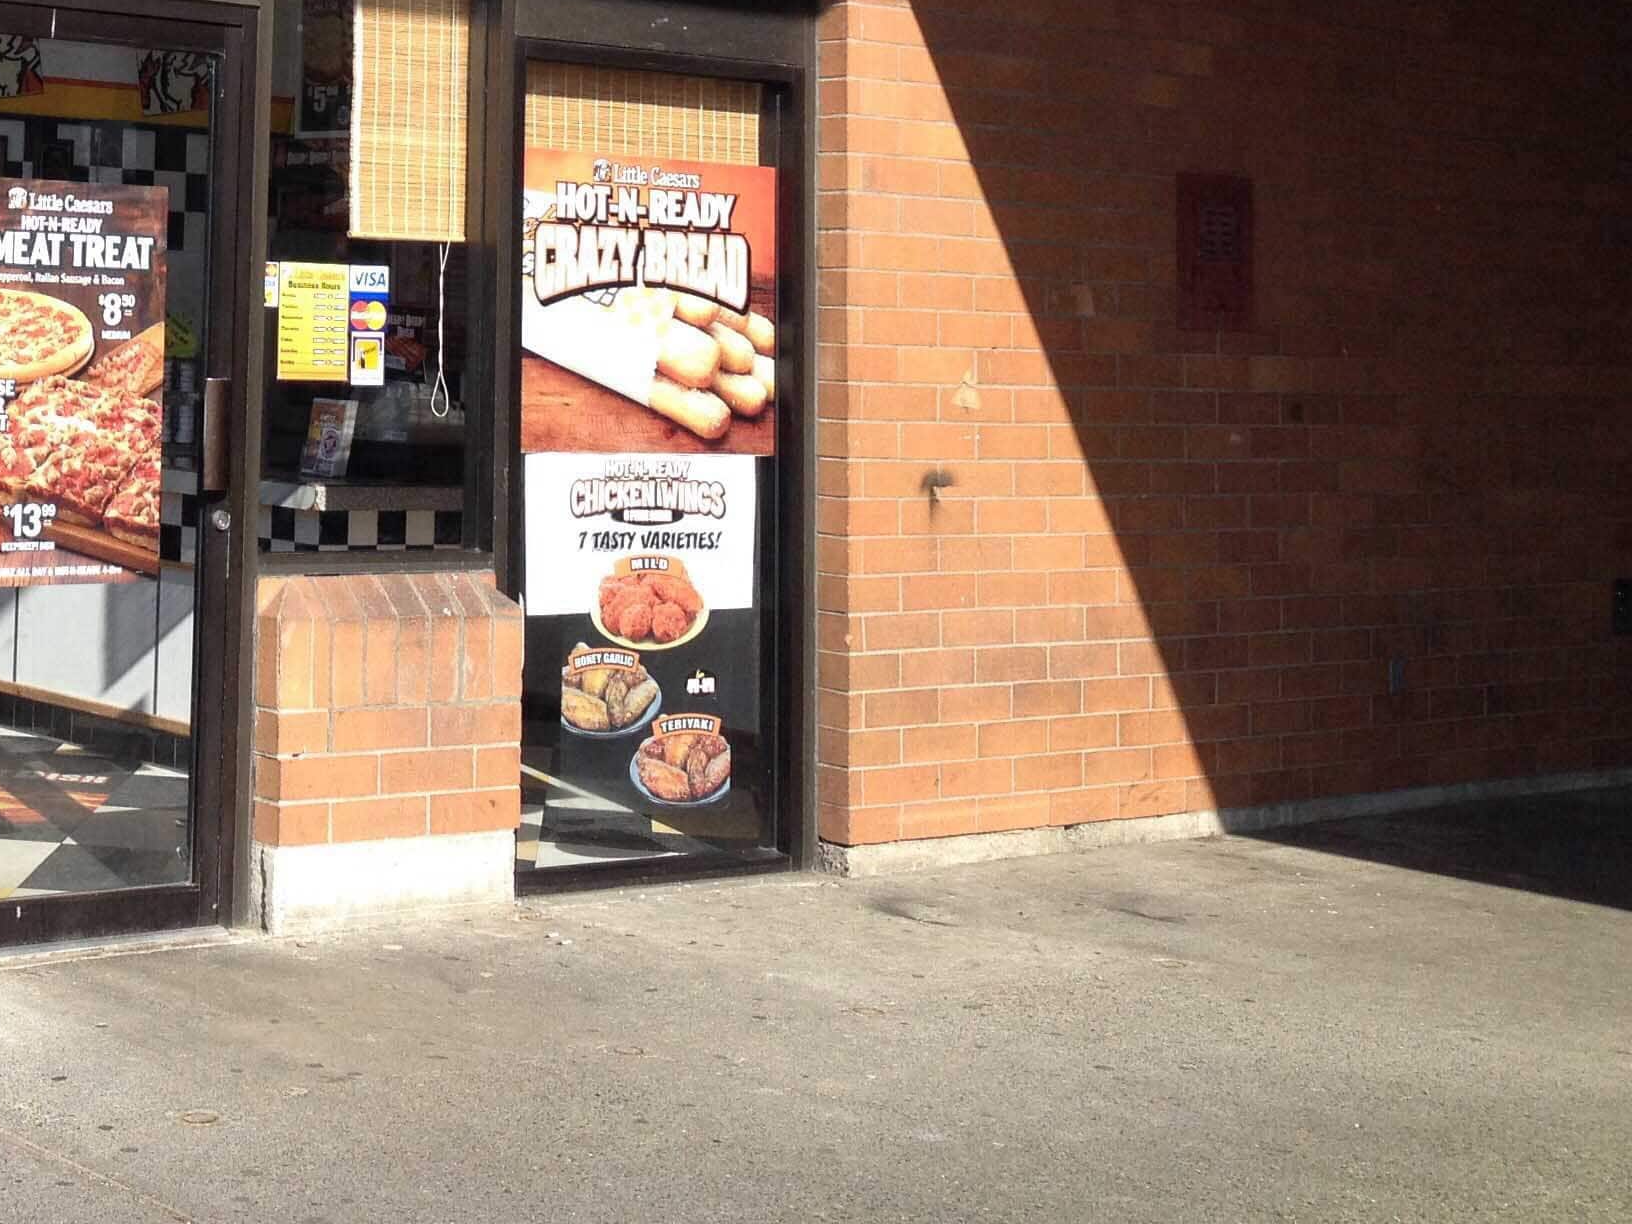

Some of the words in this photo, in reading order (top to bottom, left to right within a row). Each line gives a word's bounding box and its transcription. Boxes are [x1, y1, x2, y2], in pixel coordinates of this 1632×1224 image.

[612, 162, 649, 185] Little
[650, 167, 701, 188] Caesars
[28, 192, 64, 212] Little
[64, 194, 114, 215] Caesars
[555, 180, 737, 230] HOT-N-READY
[69, 233, 155, 270] TREAT
[355, 271, 387, 287] VISA
[534, 221, 641, 307] CRAZY
[641, 226, 752, 316] BREAD
[570, 478, 656, 519] CHICKEN
[658, 479, 727, 520] WINGS
[578, 531, 588, 550] 7
[592, 531, 636, 550] TASTY
[641, 530, 723, 551] VARIETIES!
[630, 557, 669, 571] MILD
[603, 652, 634, 667] GARLIC
[660, 718, 715, 733] TERIYAKI
